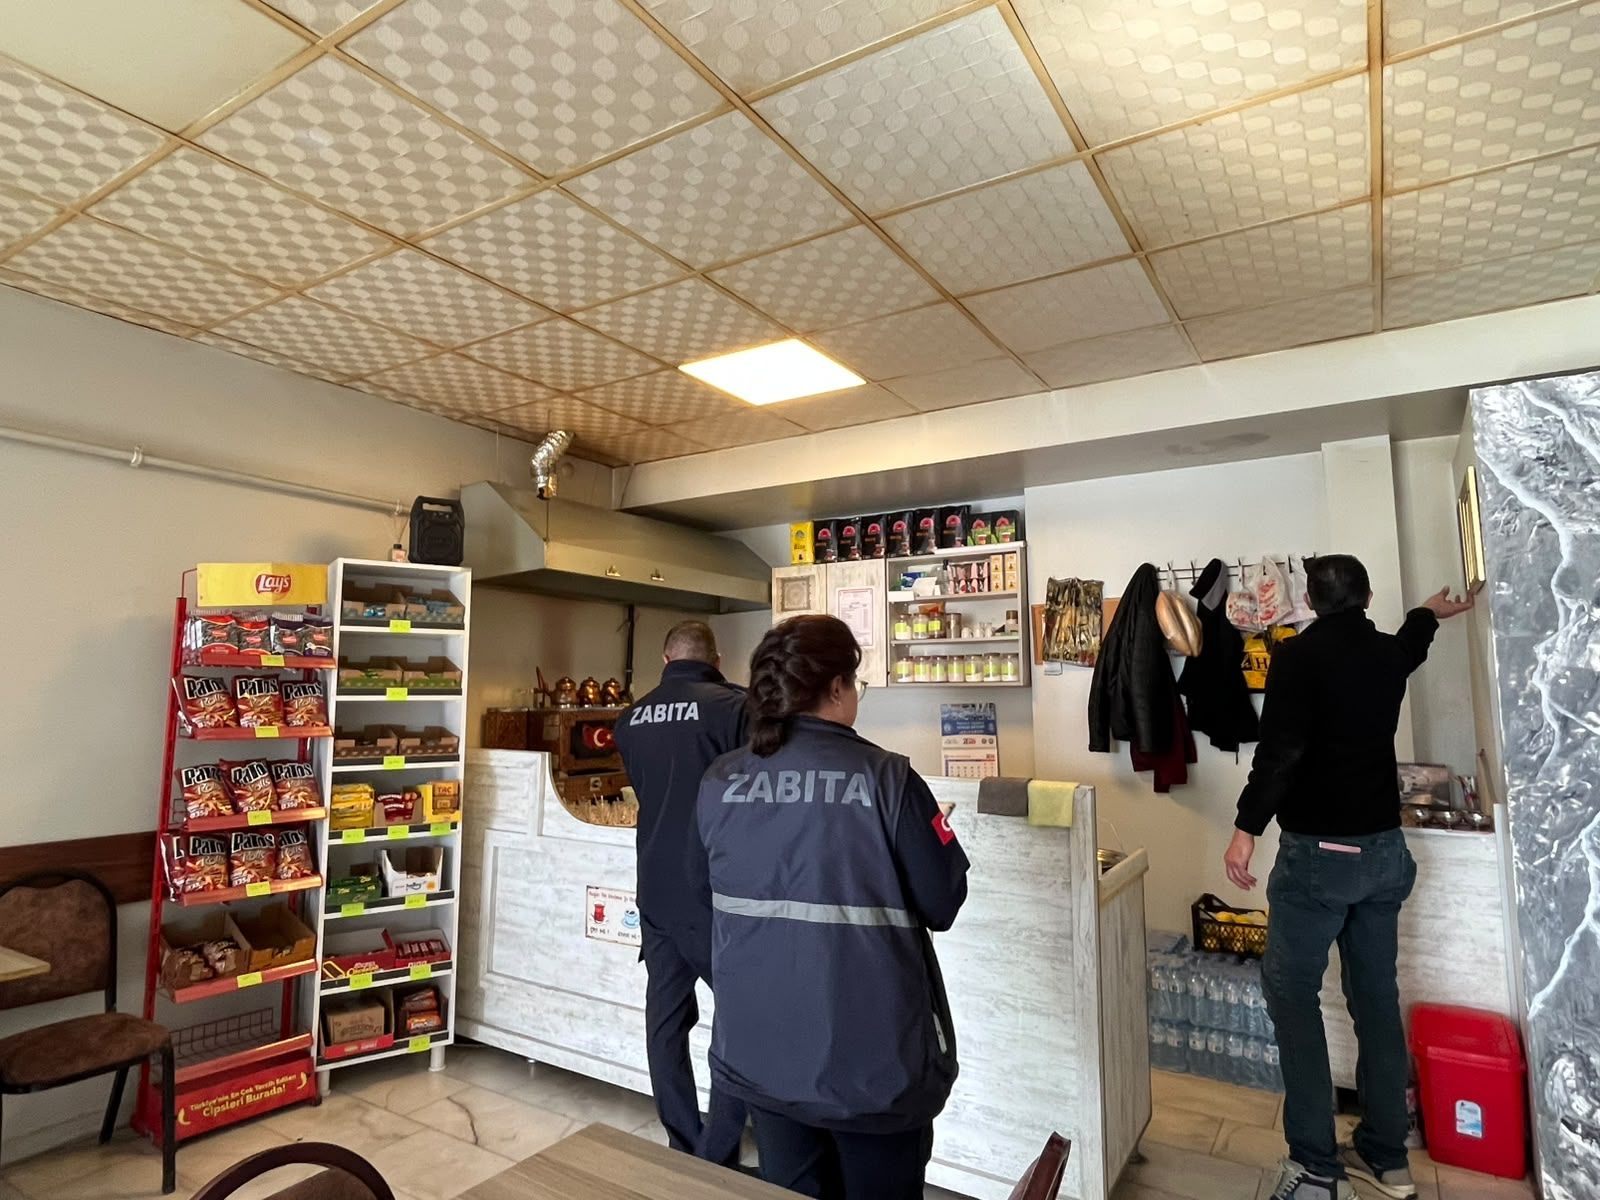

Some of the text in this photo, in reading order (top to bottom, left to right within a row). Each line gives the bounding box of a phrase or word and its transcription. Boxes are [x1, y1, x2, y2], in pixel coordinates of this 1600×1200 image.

[237, 678, 279, 698] Patos
[629, 702, 699, 726] ZABITA
[231, 761, 269, 784] Pato
[272, 762, 314, 782] Patos
[722, 770, 872, 807] ZABITA
[231, 832, 275, 854] Patos
[246, 1084, 286, 1104] Burada!
